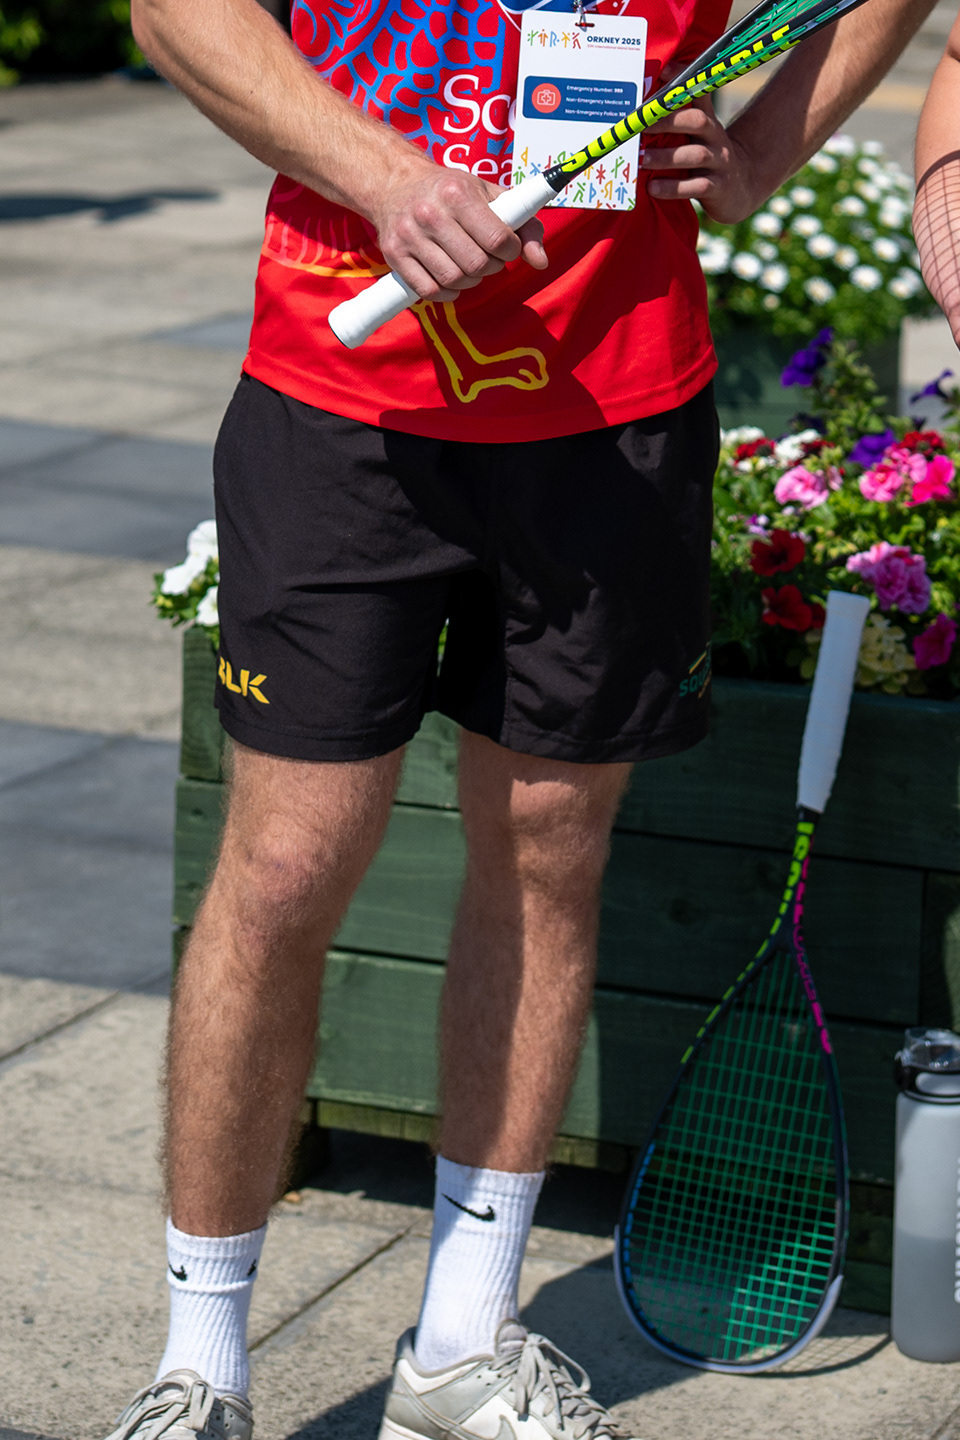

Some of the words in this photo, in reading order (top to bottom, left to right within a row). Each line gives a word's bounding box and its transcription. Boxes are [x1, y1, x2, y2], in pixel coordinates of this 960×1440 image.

[586, 35, 620, 44] ORKNEY
[621, 37, 641, 45] 2025
[566, 85, 593, 93] Emergency
[564, 108, 602, 116] Non-Emergency
